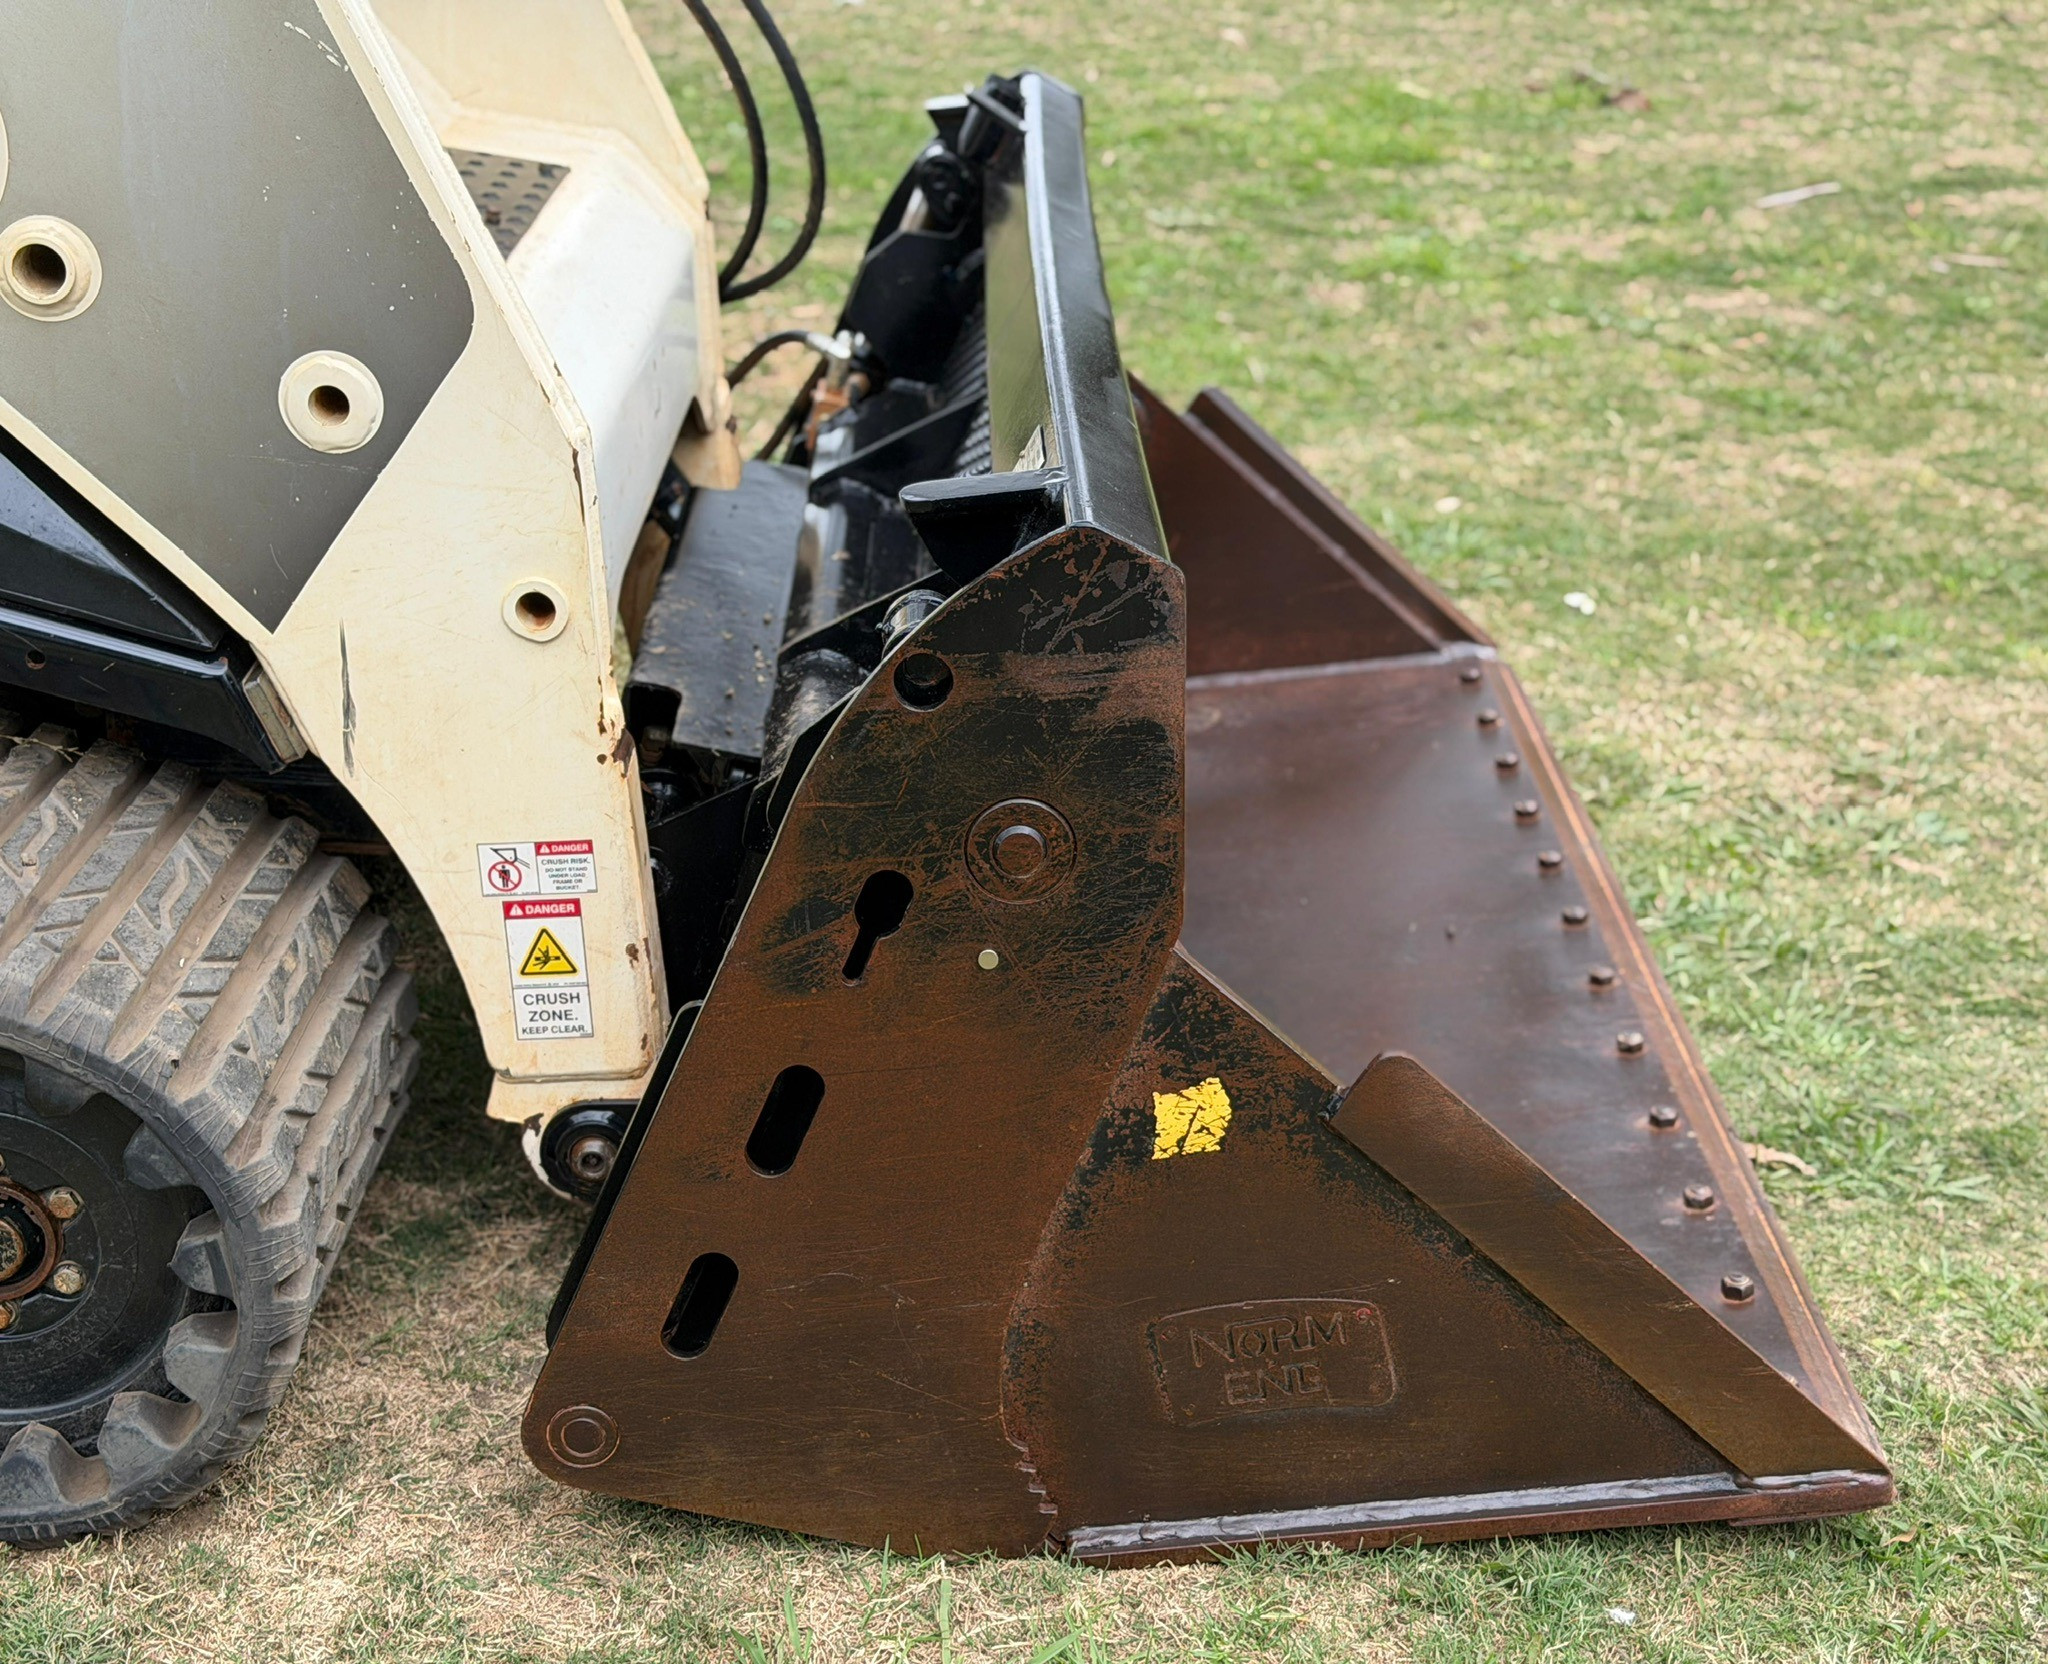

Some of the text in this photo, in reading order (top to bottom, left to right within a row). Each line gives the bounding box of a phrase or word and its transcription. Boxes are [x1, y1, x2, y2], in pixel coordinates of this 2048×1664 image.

[551, 843, 589, 852] DANGER
[541, 858, 569, 866] CRUSH
[525, 903, 575, 915] DANGER
[523, 992, 581, 1006] CRUSH
[528, 1009, 578, 1022] ZONE.
[522, 1024, 588, 1035] KEEP CLEAR.
[1190, 1311, 1348, 1367] NORM
